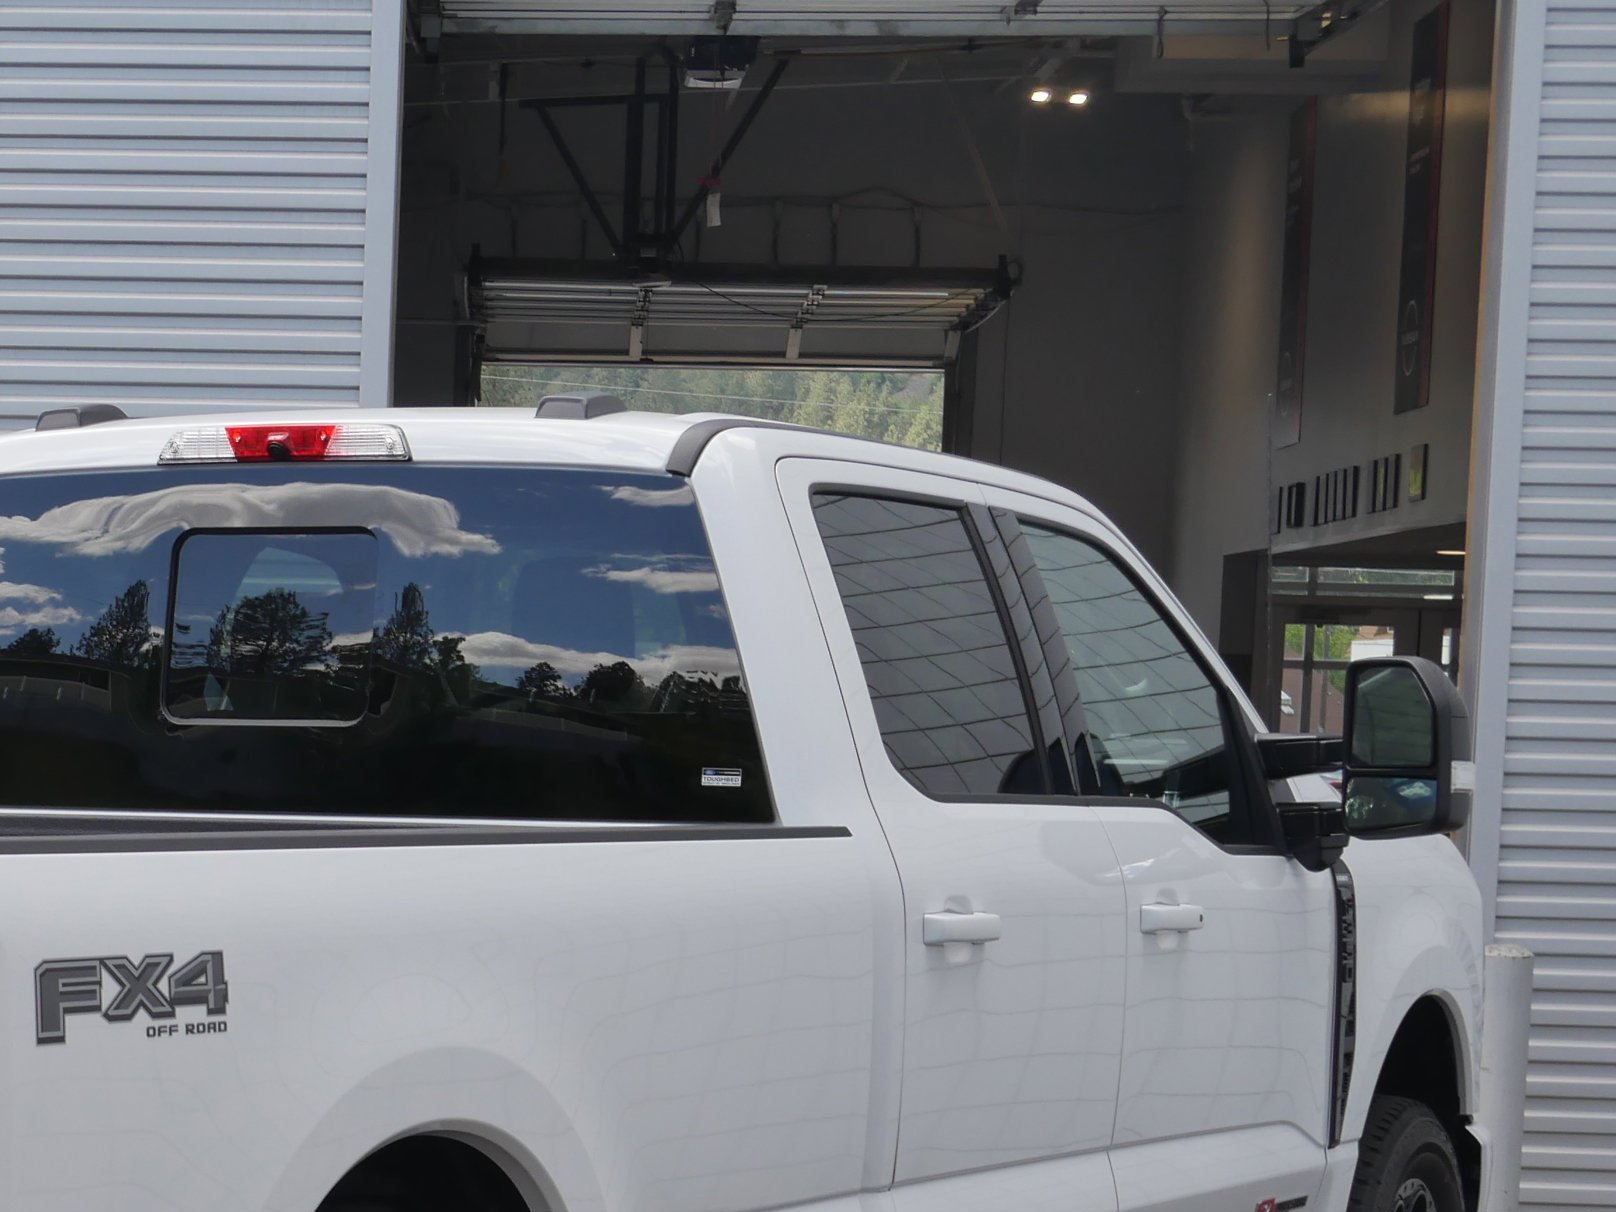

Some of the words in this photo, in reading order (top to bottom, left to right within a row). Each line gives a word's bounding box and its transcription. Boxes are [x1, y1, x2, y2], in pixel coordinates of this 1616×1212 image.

[34, 950, 229, 1045] FX4
[146, 1023, 180, 1038] OFF
[185, 1020, 228, 1035] ROAD
